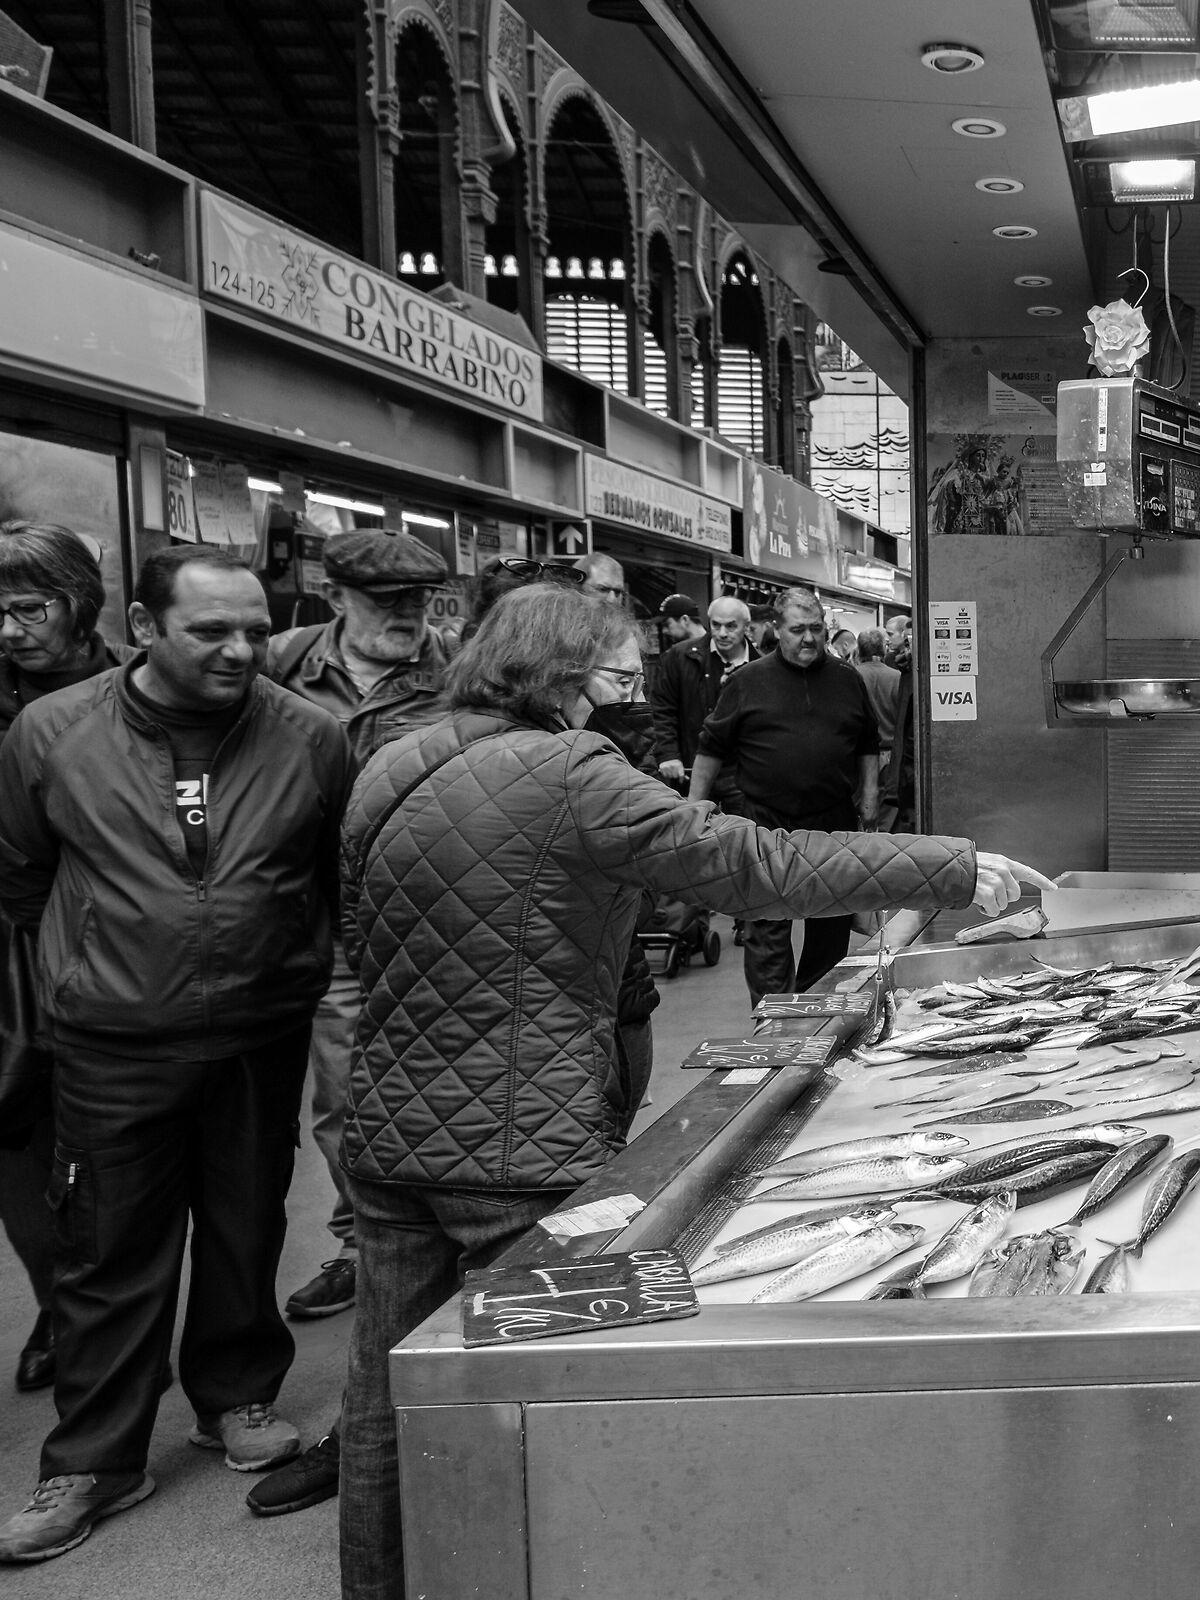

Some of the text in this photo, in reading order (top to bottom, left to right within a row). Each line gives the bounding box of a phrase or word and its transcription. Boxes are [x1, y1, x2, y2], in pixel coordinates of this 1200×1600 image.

[211, 261, 275, 309] 124-125
[321, 261, 534, 383] CONGELADOS
[343, 303, 526, 408] BARRABINO
[936, 691, 974, 705] VISA
[628, 1250, 694, 1314] CABALLA
